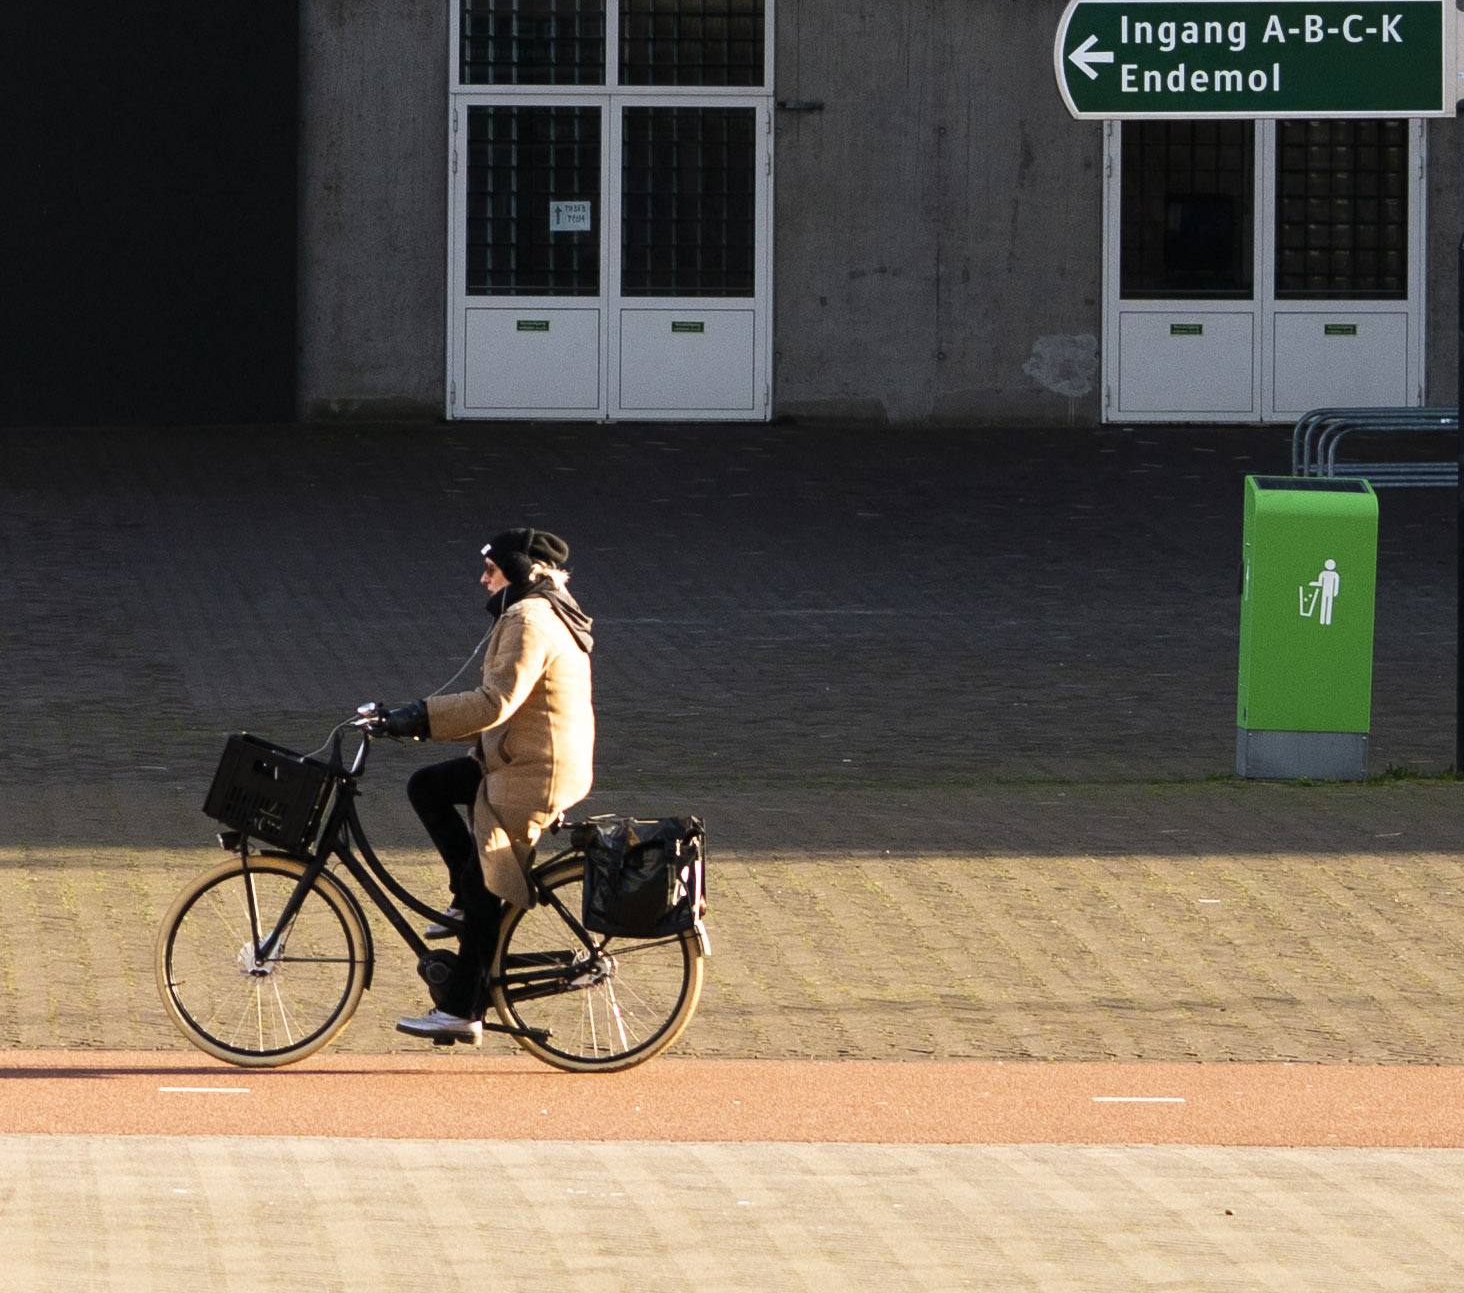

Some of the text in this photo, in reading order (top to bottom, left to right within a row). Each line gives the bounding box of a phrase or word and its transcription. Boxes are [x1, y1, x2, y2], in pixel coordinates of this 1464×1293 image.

[1120, 14, 1404, 51] Ingang A-B-C-K
[1121, 63, 1281, 93] Endemol
